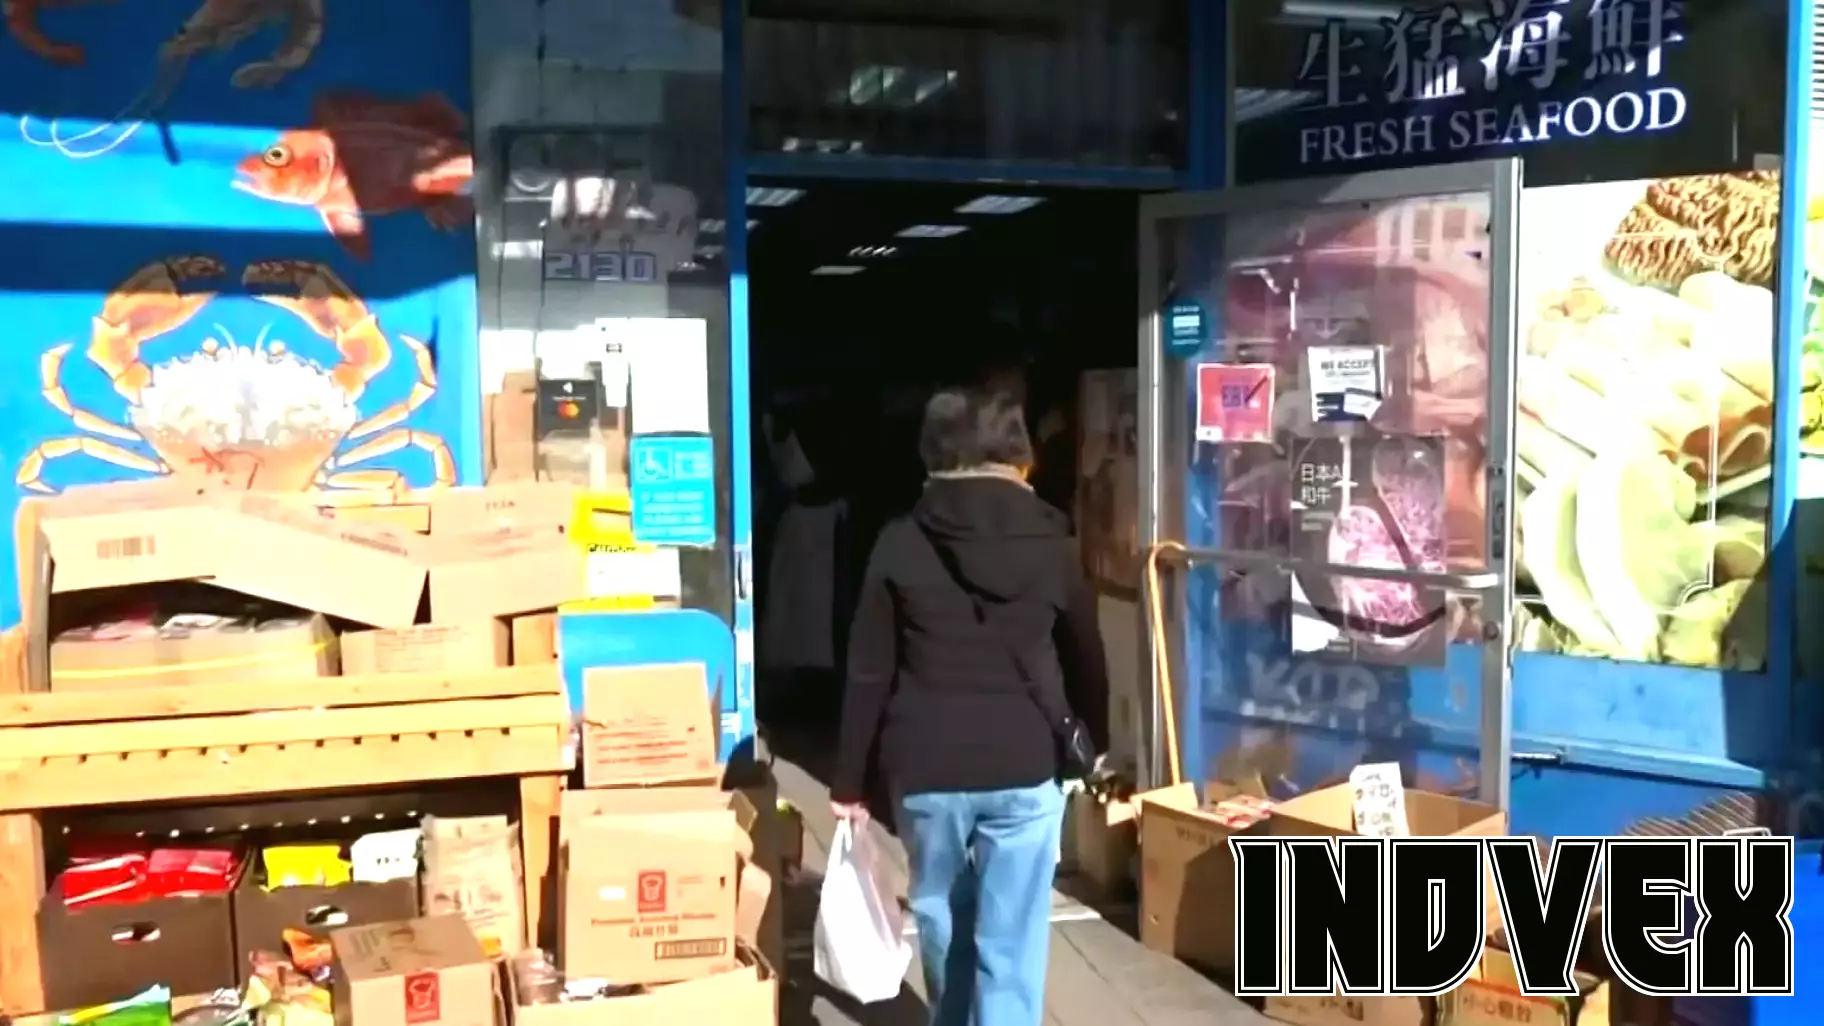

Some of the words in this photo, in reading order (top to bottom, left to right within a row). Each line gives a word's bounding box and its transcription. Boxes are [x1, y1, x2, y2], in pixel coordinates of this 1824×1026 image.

[1297, 0, 1684, 111] 生猛海鮮
[1300, 115, 1435, 164] FRESH
[1450, 87, 1686, 149] SEAFOOD
[545, 252, 657, 281] 2130
